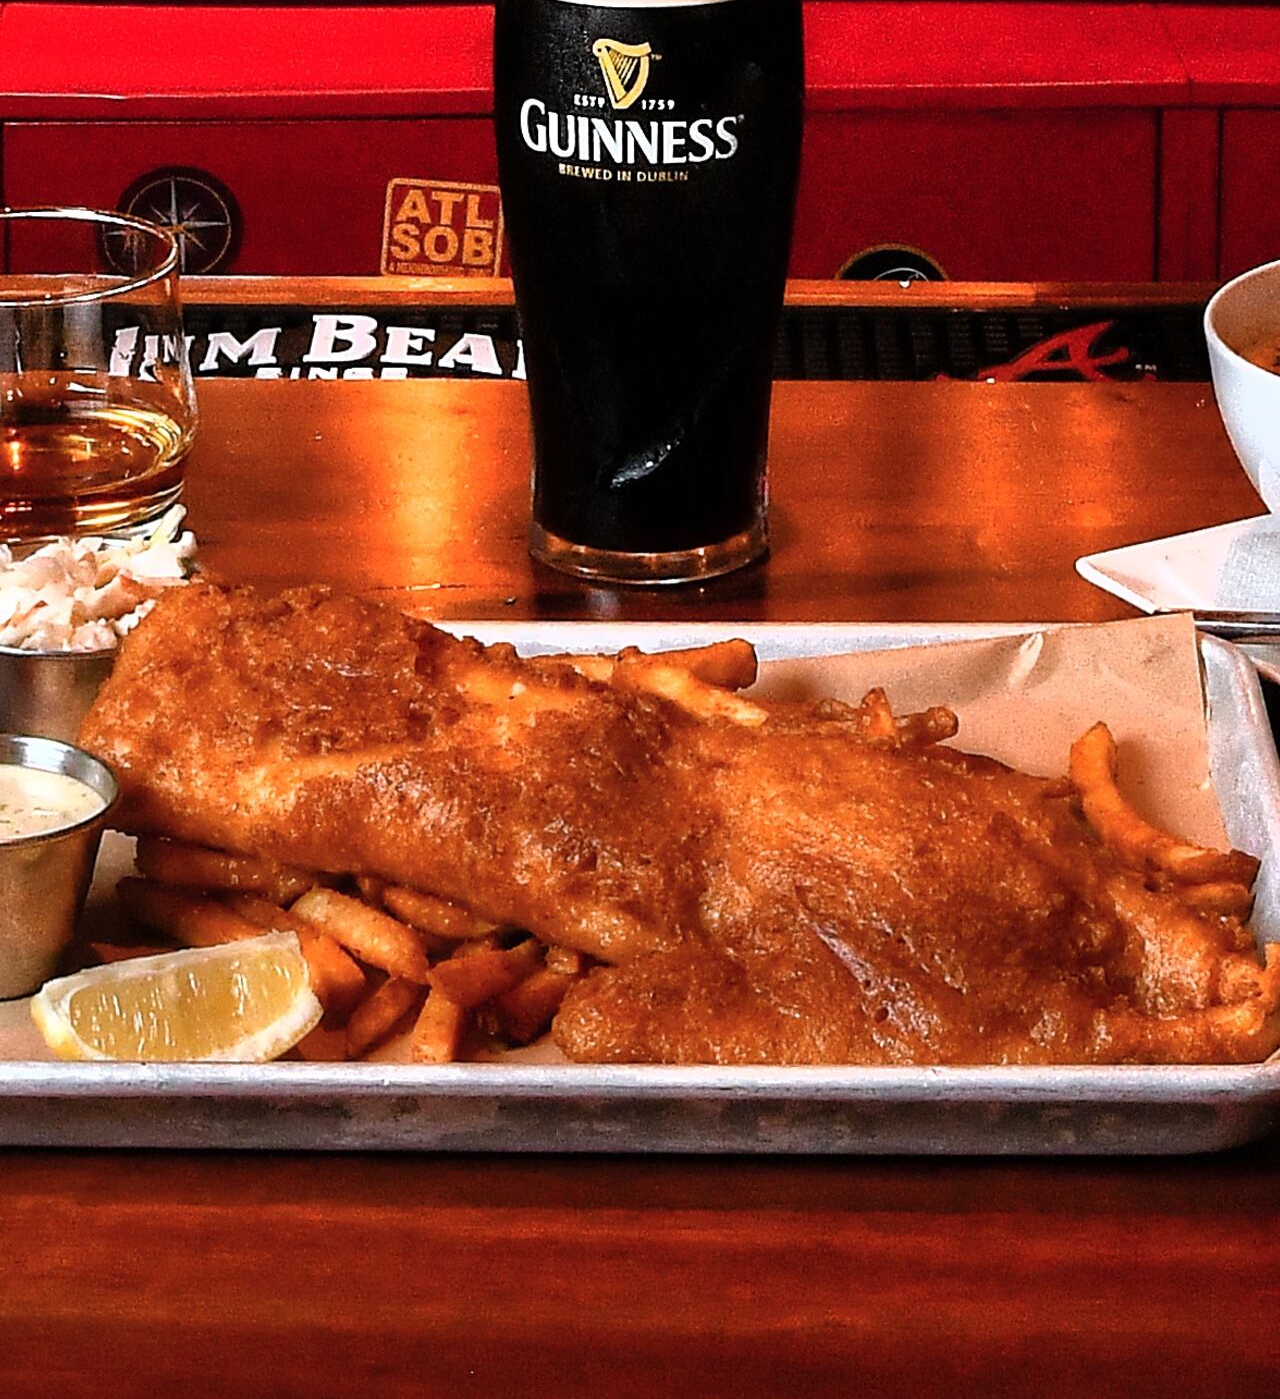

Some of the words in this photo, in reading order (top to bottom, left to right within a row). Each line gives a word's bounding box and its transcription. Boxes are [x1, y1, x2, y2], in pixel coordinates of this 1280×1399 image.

[641, 99, 675, 111] 1759
[520, 98, 739, 165] GUINNESS
[558, 163, 613, 181] BREWED
[617, 170, 632, 182] IN
[636, 170, 689, 183] DUBLIN
[395, 189, 494, 229] ATL
[390, 223, 494, 265] SOB
[302, 314, 528, 381] BEA
